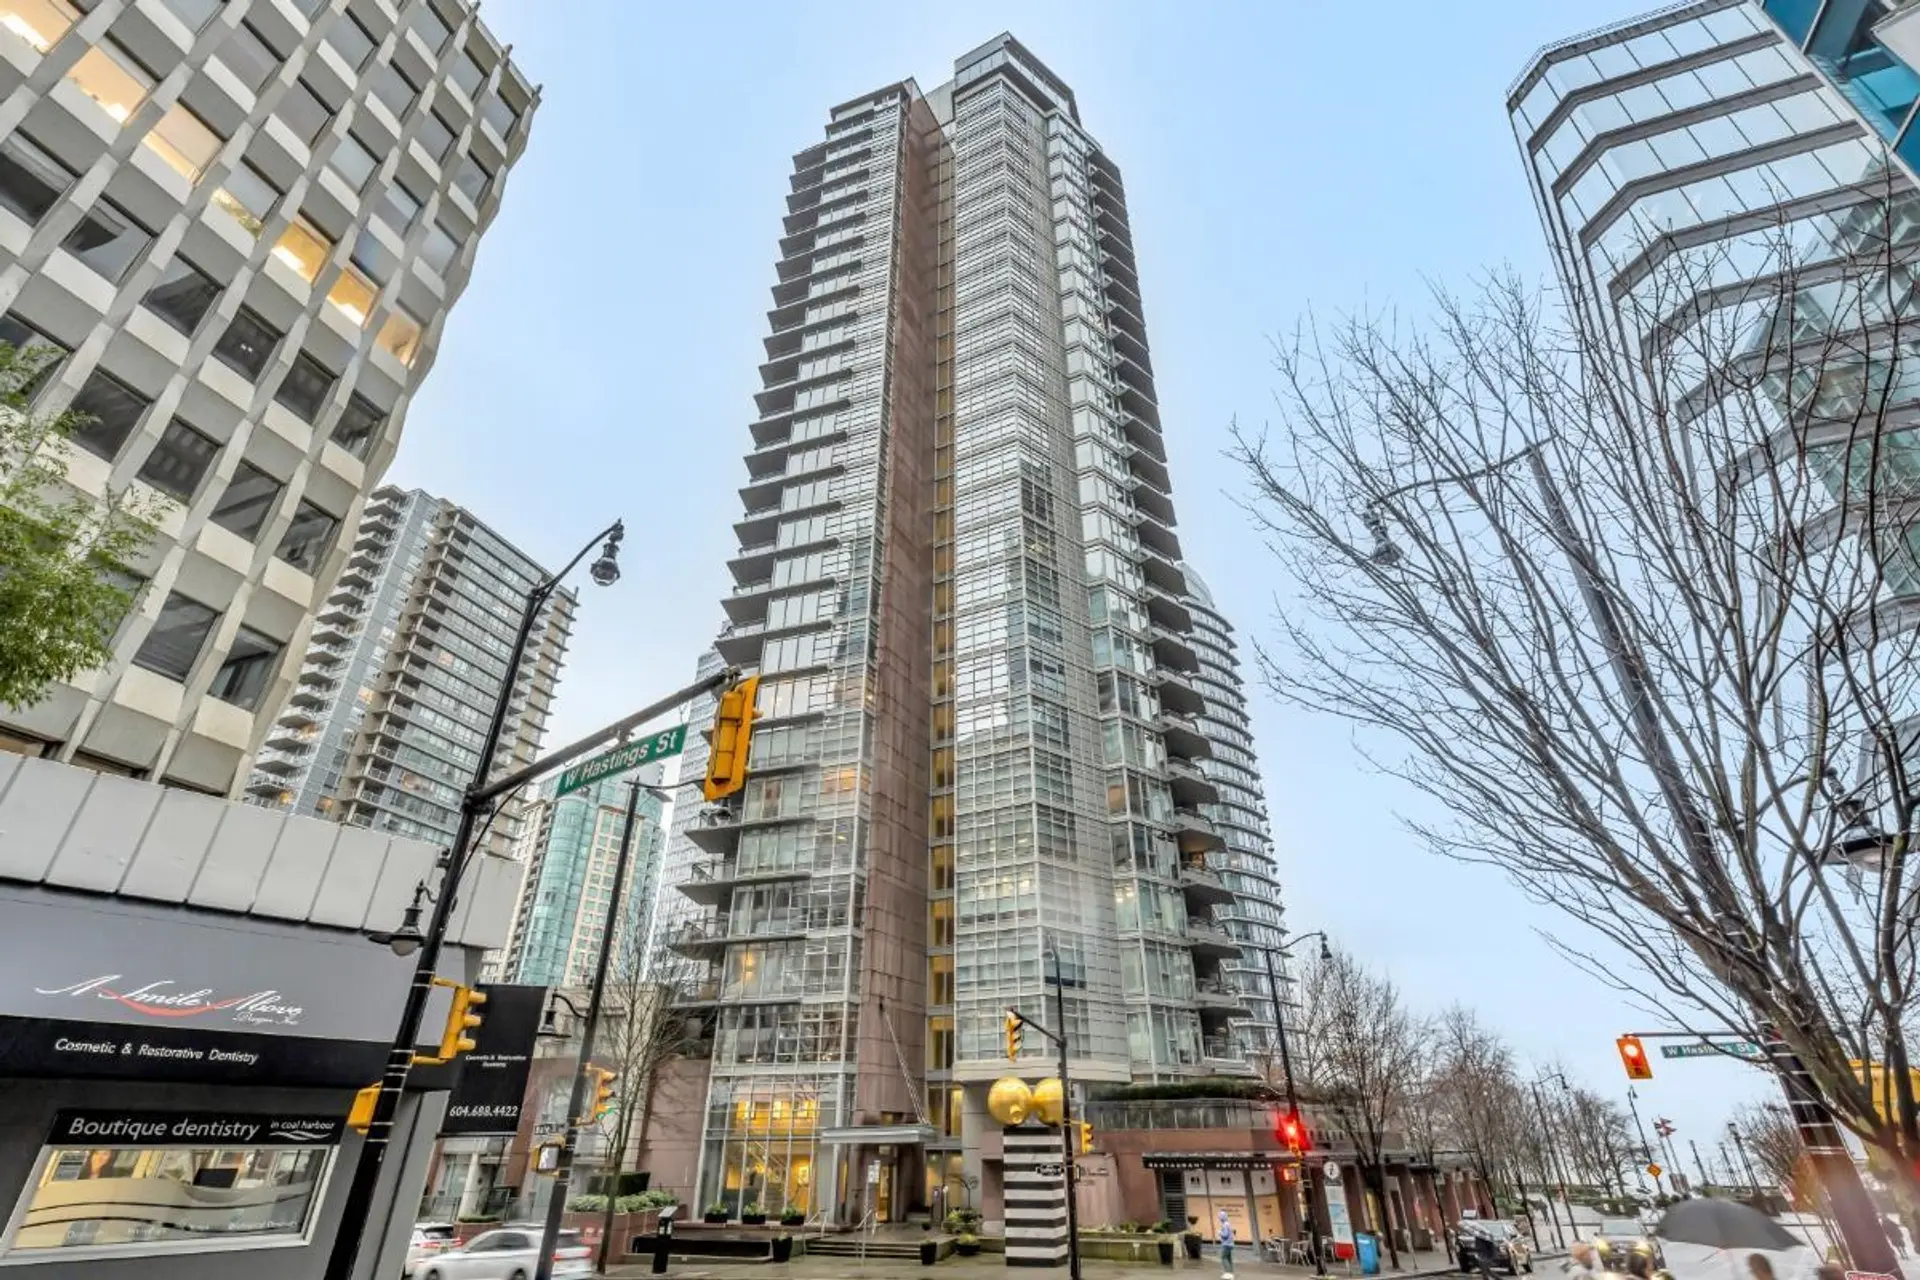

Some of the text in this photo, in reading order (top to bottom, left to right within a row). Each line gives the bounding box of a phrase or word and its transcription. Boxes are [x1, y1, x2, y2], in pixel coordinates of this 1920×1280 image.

[564, 730, 678, 788] W Hastings St
[55, 1038, 260, 1066] Cosmetic & Restorative Dentistry
[449, 1104, 519, 1118] 604.688.4422
[68, 1117, 336, 1141] Boutique dentistry in coal harbour
